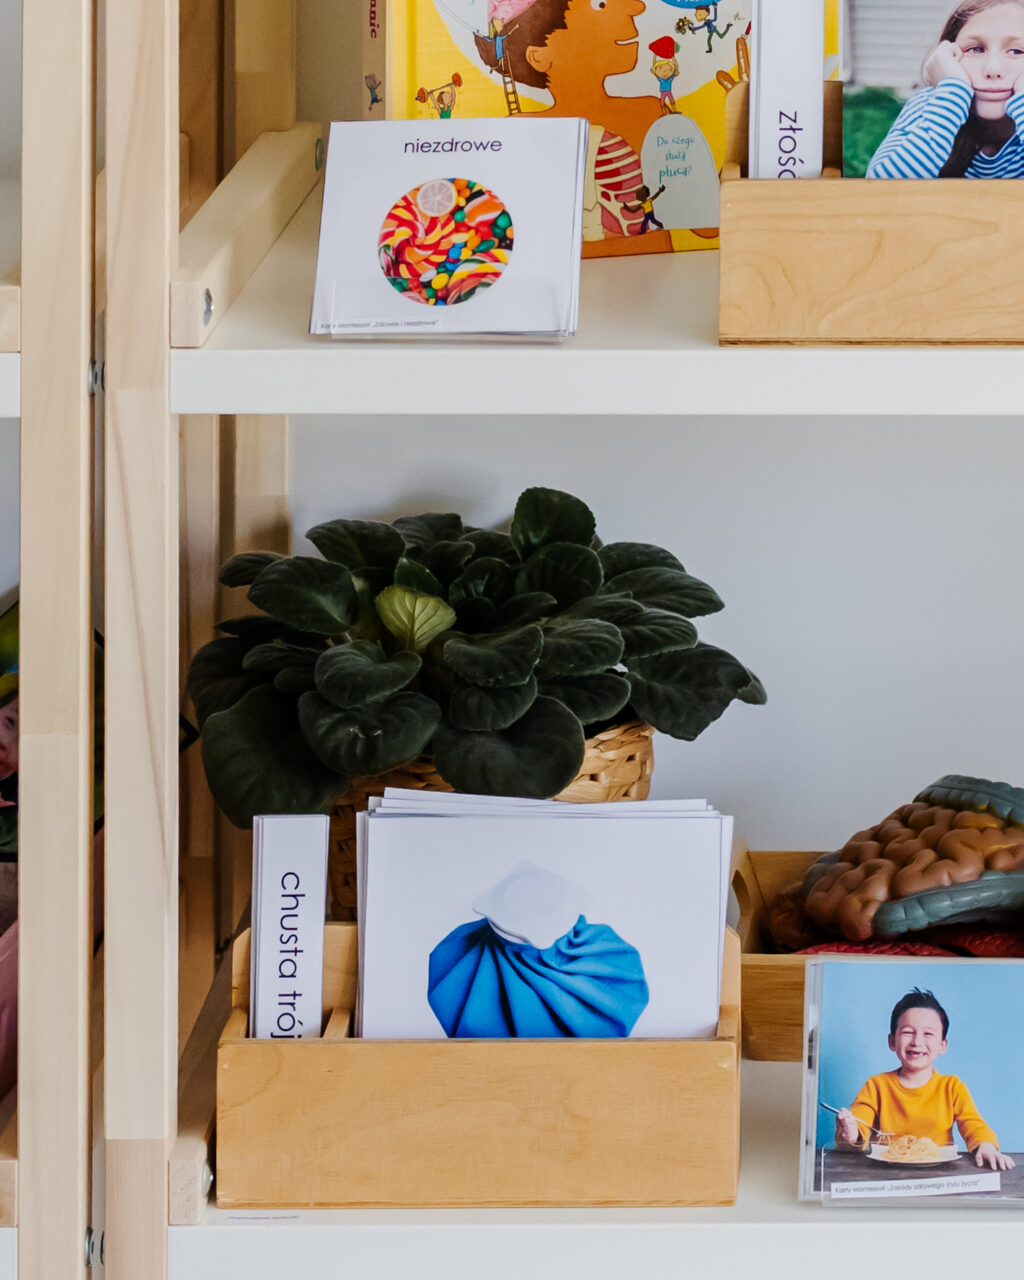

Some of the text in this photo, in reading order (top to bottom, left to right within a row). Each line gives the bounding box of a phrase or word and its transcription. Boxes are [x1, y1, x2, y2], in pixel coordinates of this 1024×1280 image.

[404, 138, 502, 153] niezdrowe
[657, 136, 695, 150] Do czego
[270, 871, 305, 1039] chusta trój
